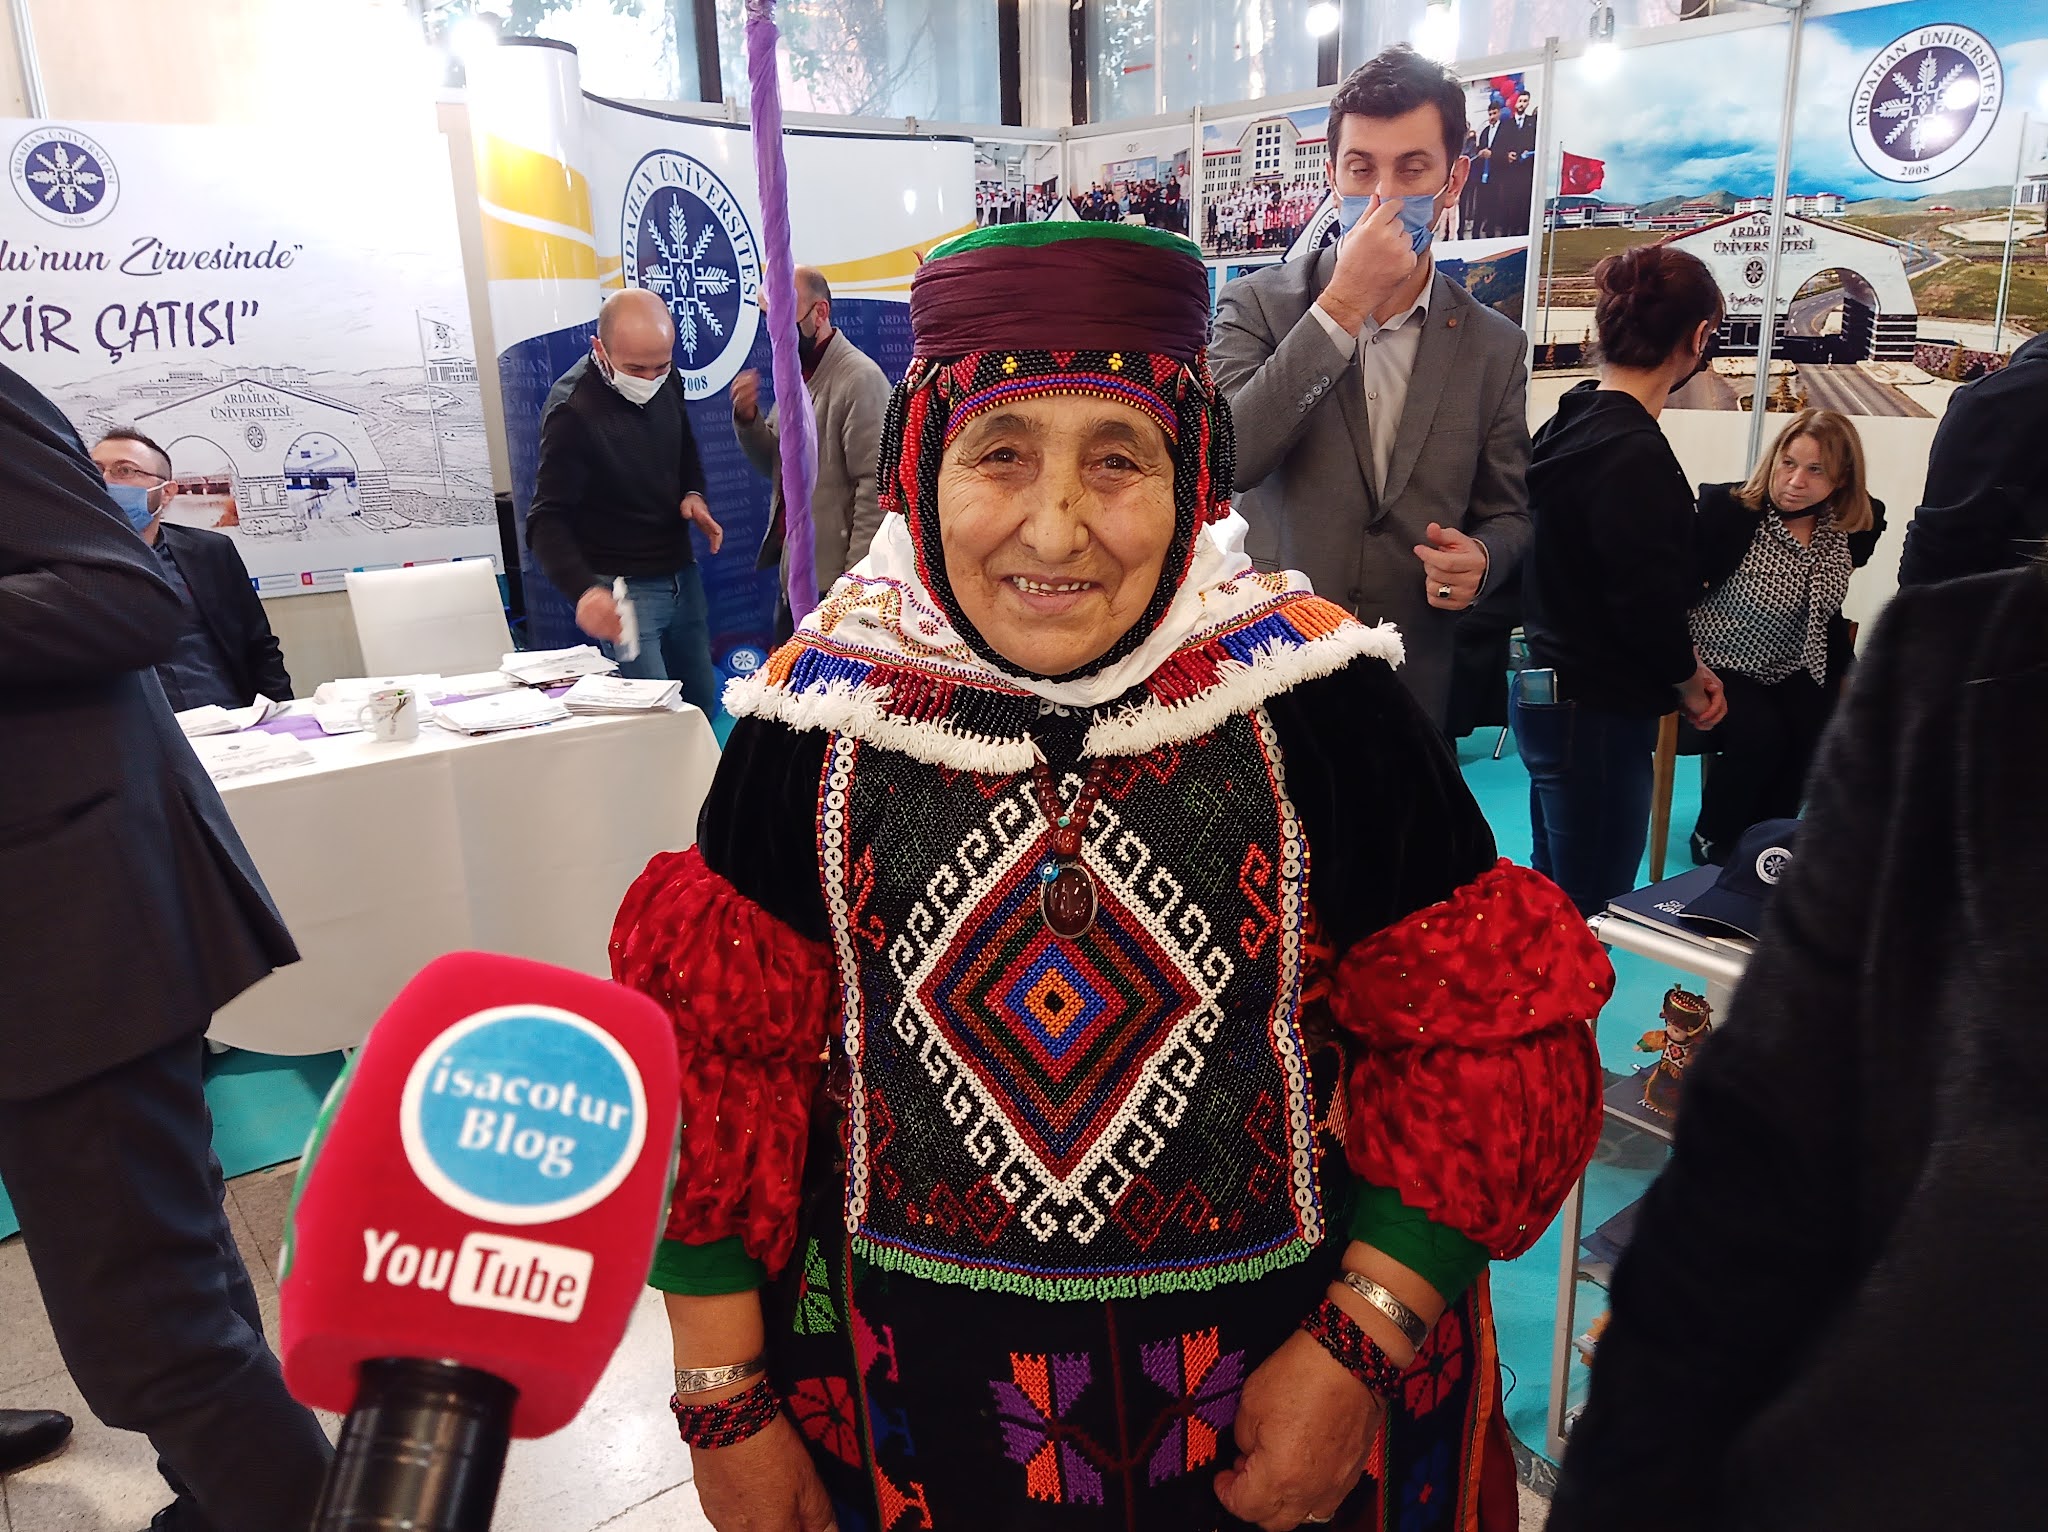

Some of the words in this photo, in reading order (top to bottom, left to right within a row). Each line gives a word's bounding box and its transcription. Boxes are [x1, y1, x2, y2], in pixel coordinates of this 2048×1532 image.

[1856, 43, 1907, 126] ARDAHAN
[1919, 29, 1997, 113] ÜNİVERSİTESİ
[14, 133, 45, 180] ARDAHAN
[1900, 164, 1930, 175] 2008
[625, 167, 655, 288] RDAHAN
[659, 156, 759, 307] ÜNİVERSİTESİ
[1311, 213, 1335, 250] DAHAN
[1730, 225, 1802, 238] ARDAHAN
[210, 404, 290, 419] ÜNİVERSİTESİ
[223, 393, 280, 405] ARDAHAN
[432, 1056, 630, 1131] isacotur
[458, 1107, 576, 1179] Blog
[362, 1229, 579, 1309] YouTube
